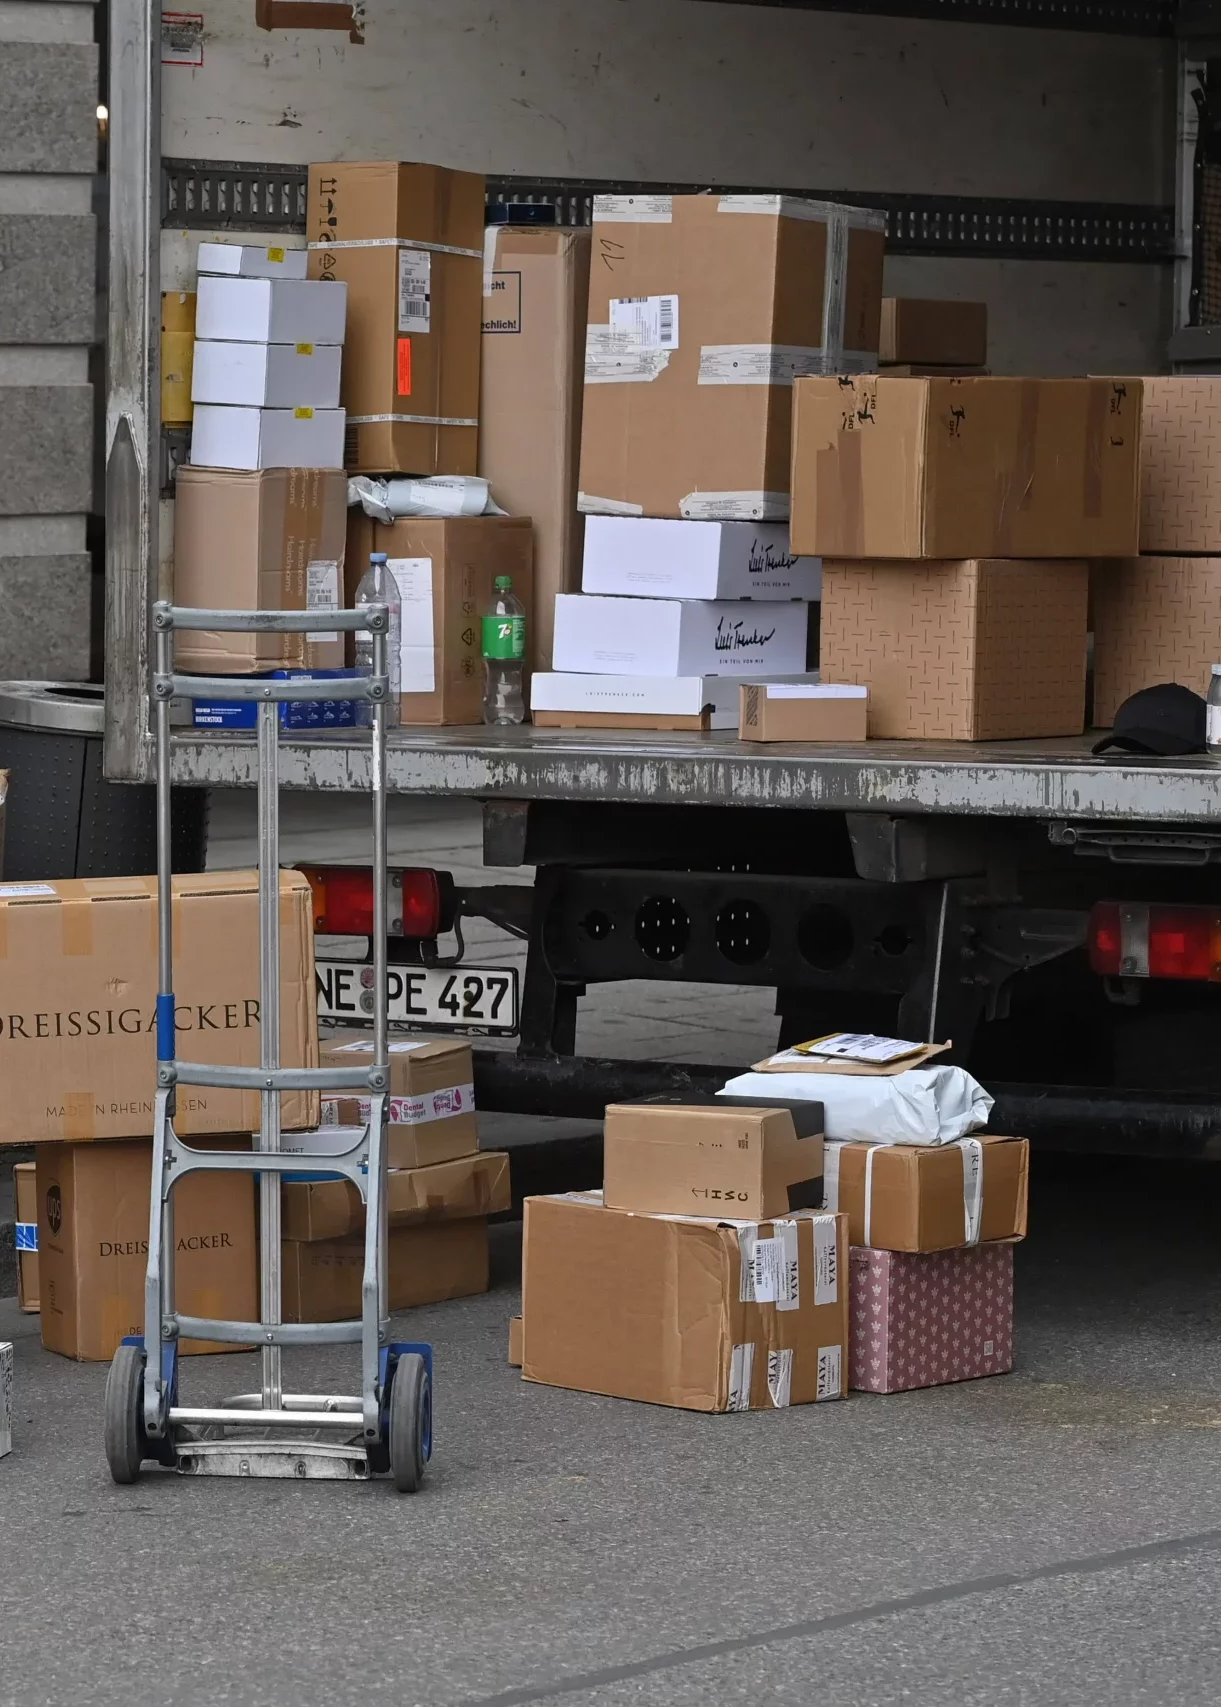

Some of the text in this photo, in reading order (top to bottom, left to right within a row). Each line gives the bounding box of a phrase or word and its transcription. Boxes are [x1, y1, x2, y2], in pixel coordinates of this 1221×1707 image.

[480, 319, 517, 330] echlich!
[315, 968, 509, 1019] NE PE 427
[110, 1099, 207, 1115] RHEINSEN
[403, 1102, 424, 1112] Dental
[403, 1107, 427, 1119] Budget
[47, 1195, 61, 1227] ups
[99, 1232, 234, 1257] DREISACKER
[828, 1245, 836, 1286] MAYA
[790, 1261, 798, 1302] MAYA
[129, 1326, 142, 1336] DE
[768, 1351, 778, 1383] MAY
[818, 1355, 826, 1395] MAYA
